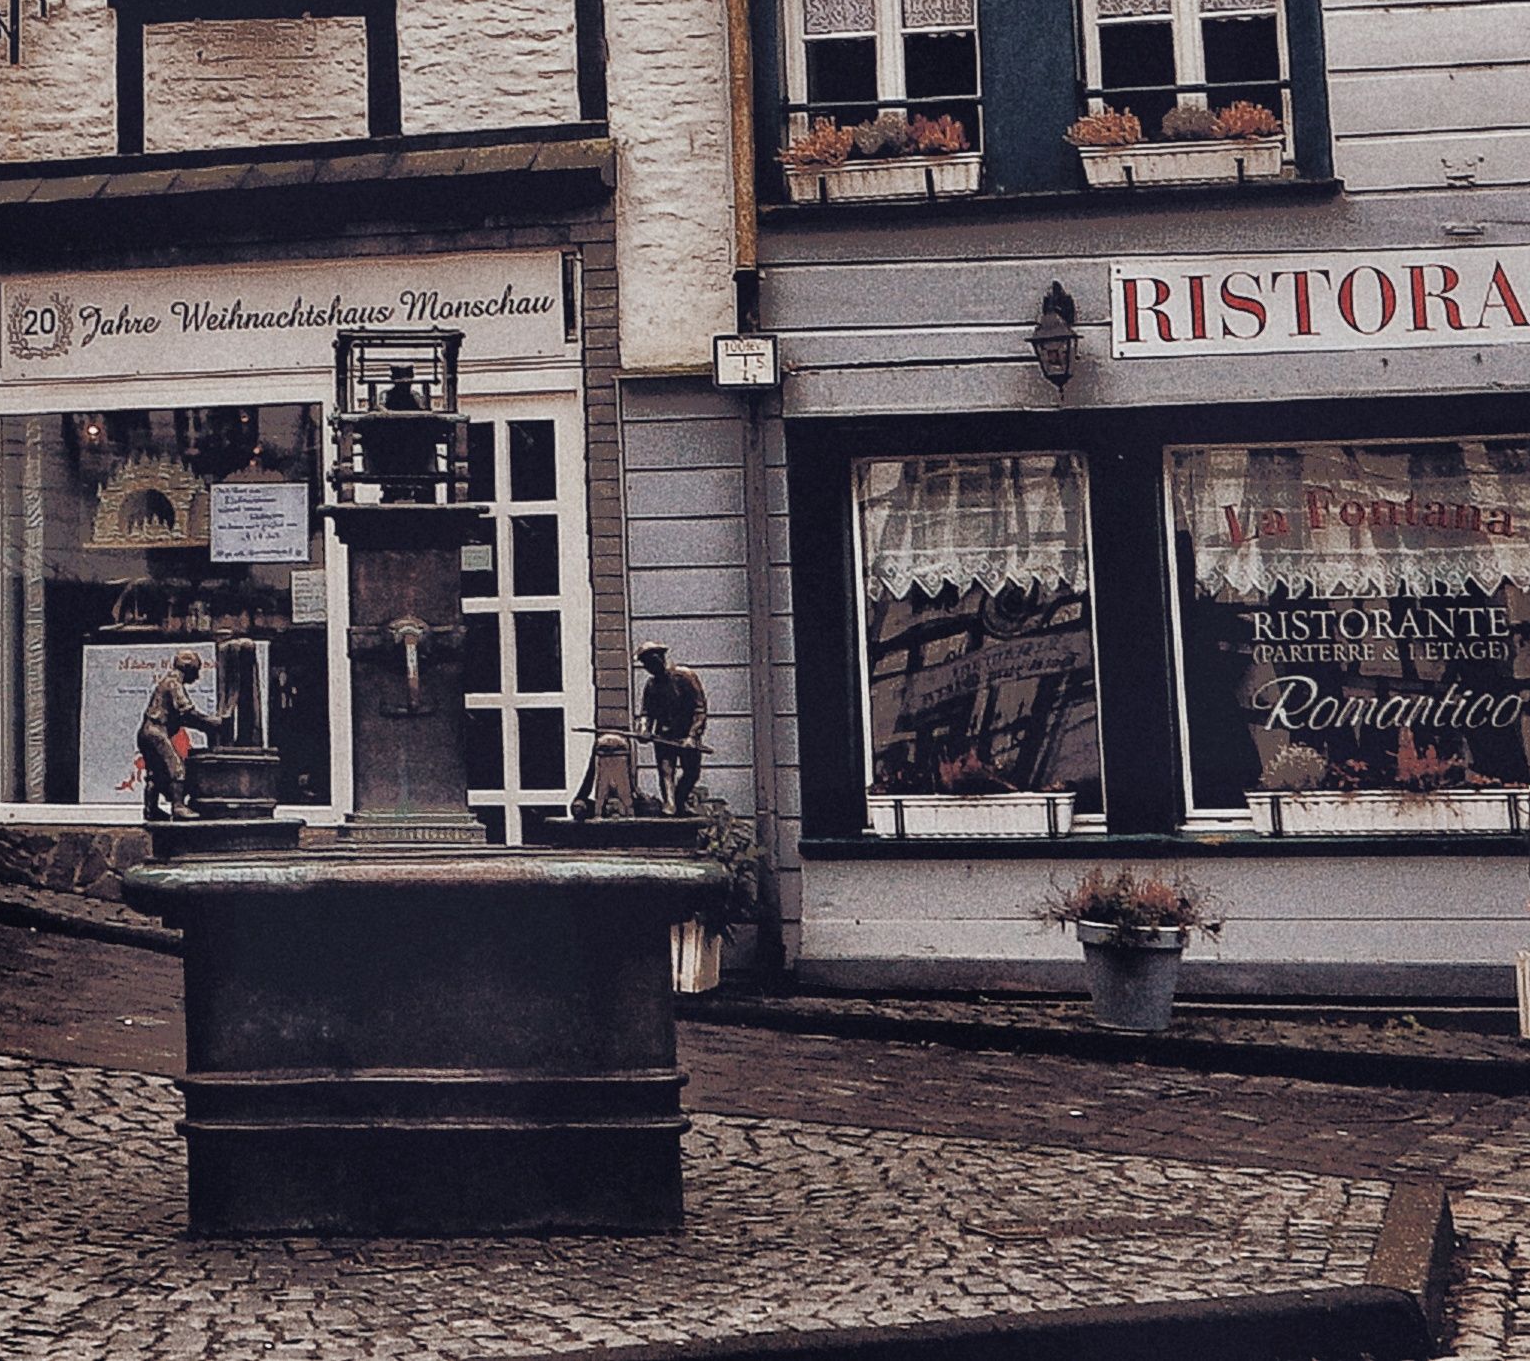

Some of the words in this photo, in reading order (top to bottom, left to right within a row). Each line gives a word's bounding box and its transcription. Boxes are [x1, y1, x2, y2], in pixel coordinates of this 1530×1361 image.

[23, 308, 56, 337] 20
[78, 305, 162, 348] Jahre
[170, 294, 396, 333] Weihnachtshaus
[399, 284, 556, 322] Monschau
[1220, 503, 1288, 547] La
[1306, 484, 1516, 538] Fontana
[1251, 606, 1510, 642] RISTORANTE
[1252, 642, 1376, 664] (PARTERRE
[1251, 675, 1525, 731] Romantico
